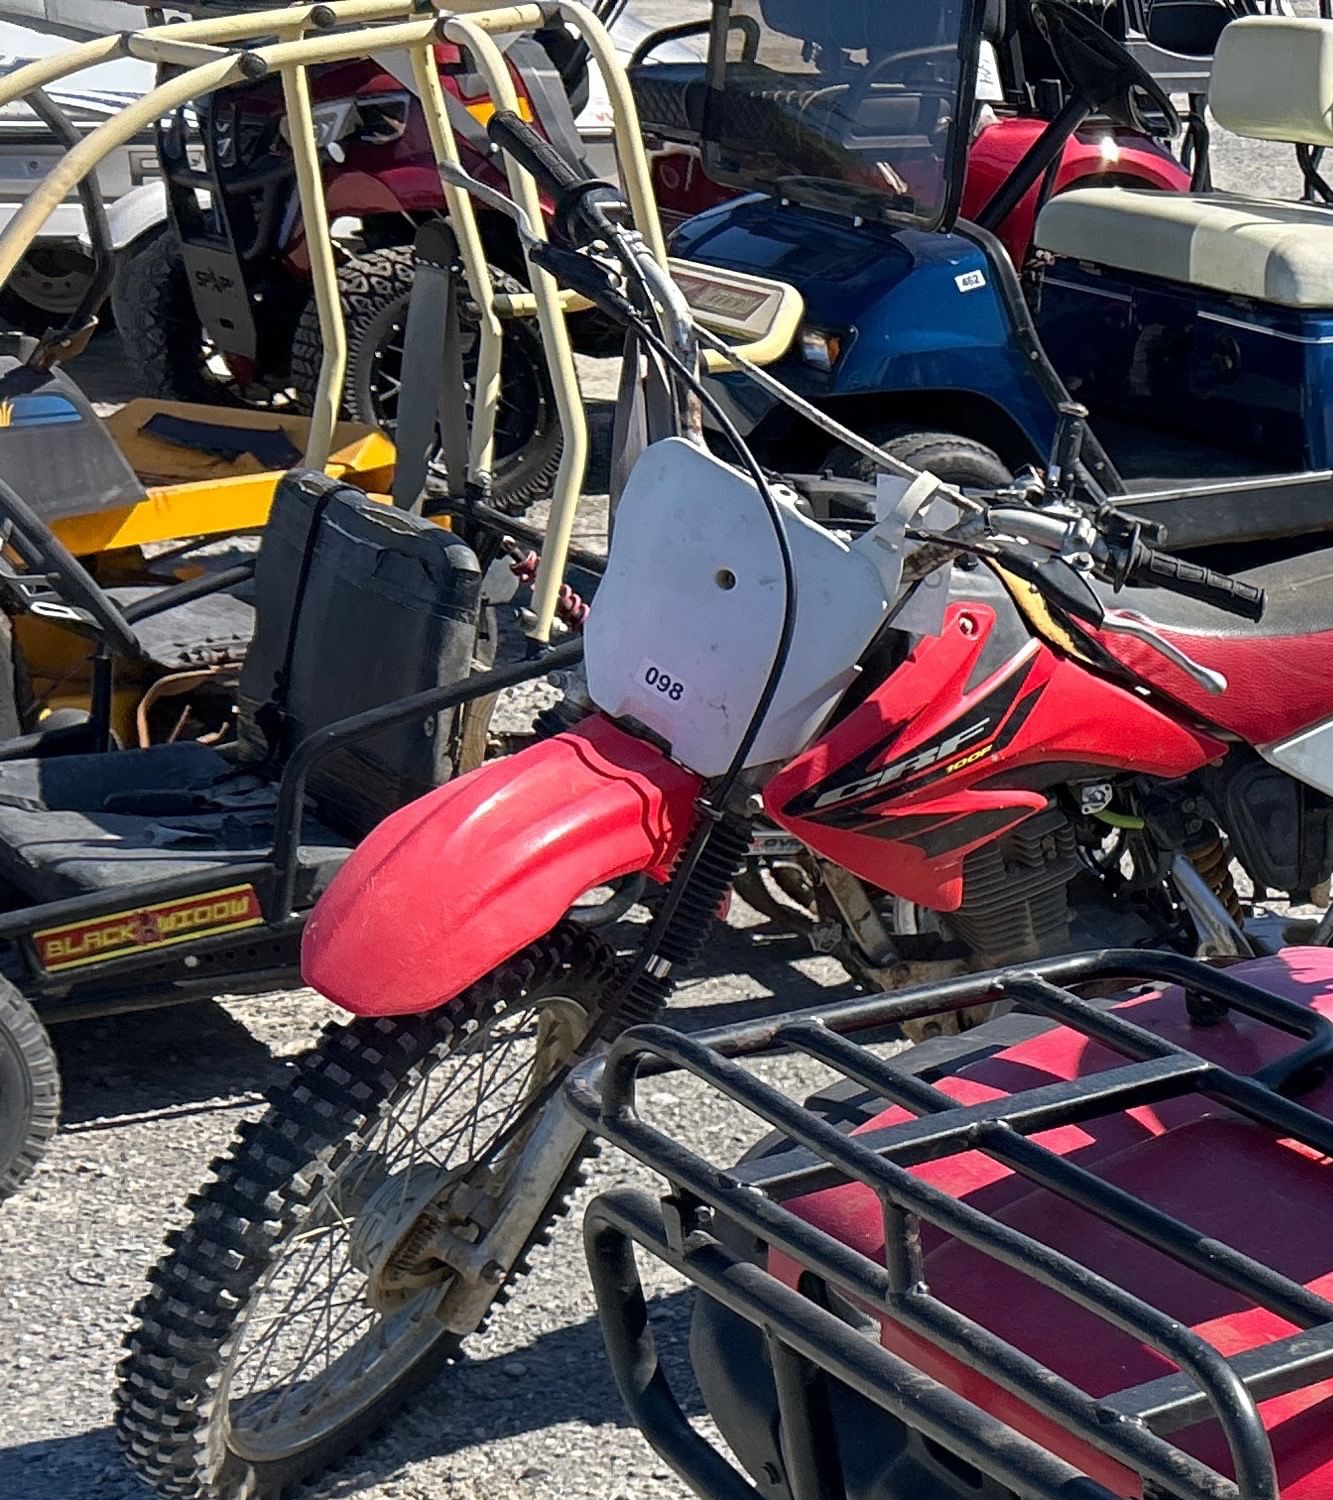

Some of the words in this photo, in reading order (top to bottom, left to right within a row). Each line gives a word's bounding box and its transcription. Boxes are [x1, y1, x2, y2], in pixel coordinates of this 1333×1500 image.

[645, 667, 684, 700] 098
[814, 717, 991, 808] CRF
[945, 744, 993, 774] 100F
[44, 922, 136, 956] BLACK
[157, 896, 250, 935] WIDOW
